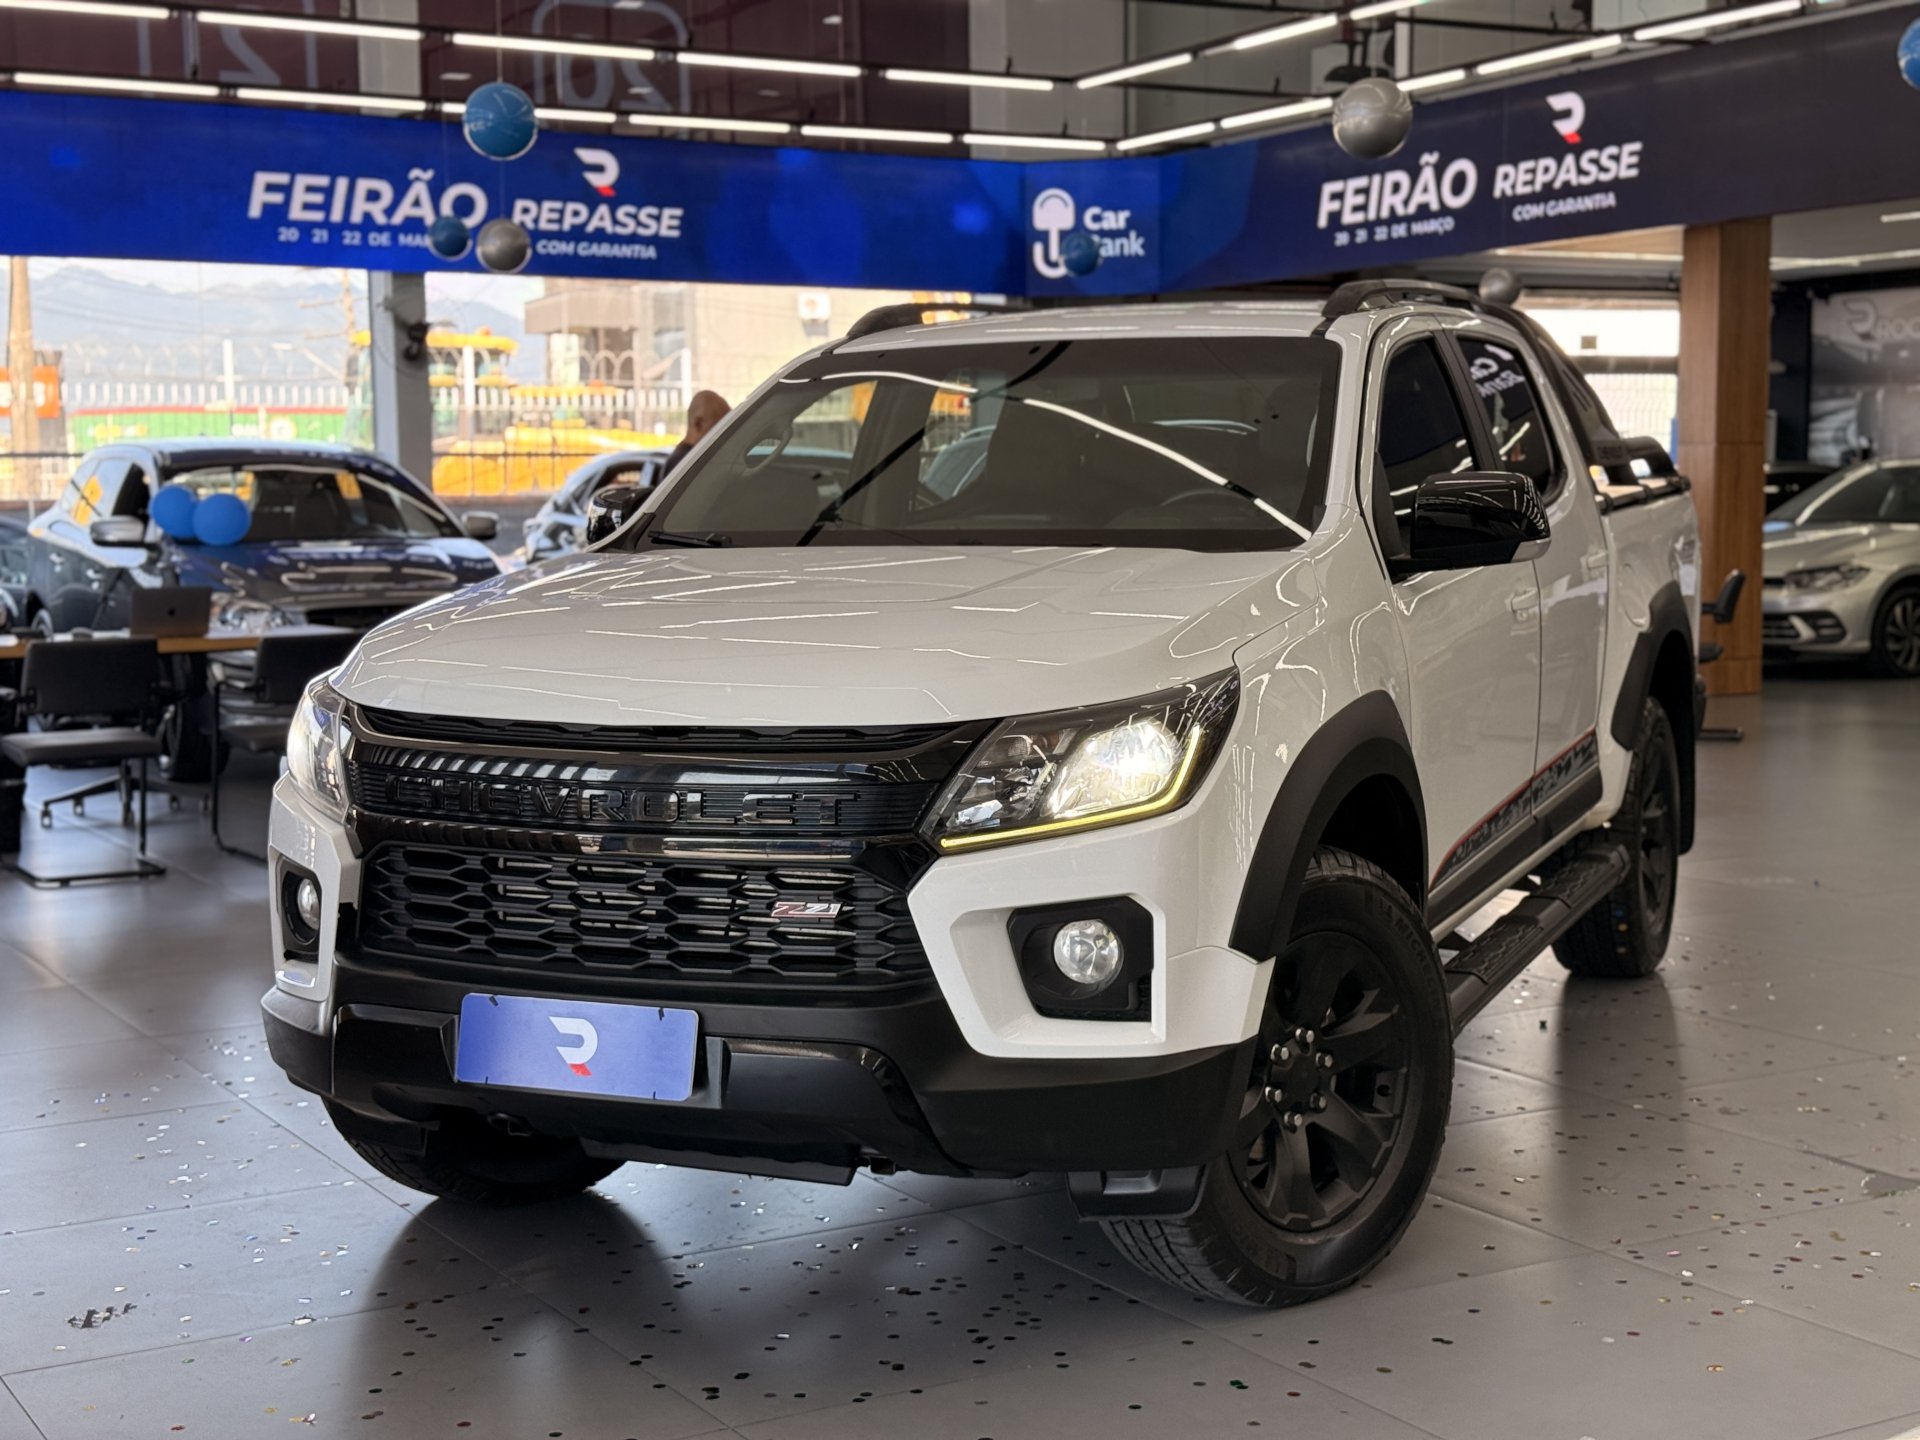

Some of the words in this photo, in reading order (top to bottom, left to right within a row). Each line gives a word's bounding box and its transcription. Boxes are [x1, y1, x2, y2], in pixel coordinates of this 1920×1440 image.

[1493, 141, 1643, 199] REPASSE
[248, 168, 489, 229] FEIRÃO
[1317, 151, 1478, 229] FEIRÃO
[511, 199, 684, 238] REPASSE
[1083, 206, 1131, 231] Car
[1512, 202, 1546, 222] COM
[1546, 191, 1617, 217] GARANTIA
[277, 227, 299, 242] 20
[311, 229, 328, 243] 21
[342, 231, 361, 246] 22
[368, 232, 391, 247] DE
[1391, 222, 1408, 238] DE
[1411, 216, 1455, 236] MARÇO
[536, 239, 575, 256] COM
[576, 241, 657, 259] GARANTIA
[1091, 230, 1145, 257] ank
[385, 773, 860, 826] CHEVROLET
